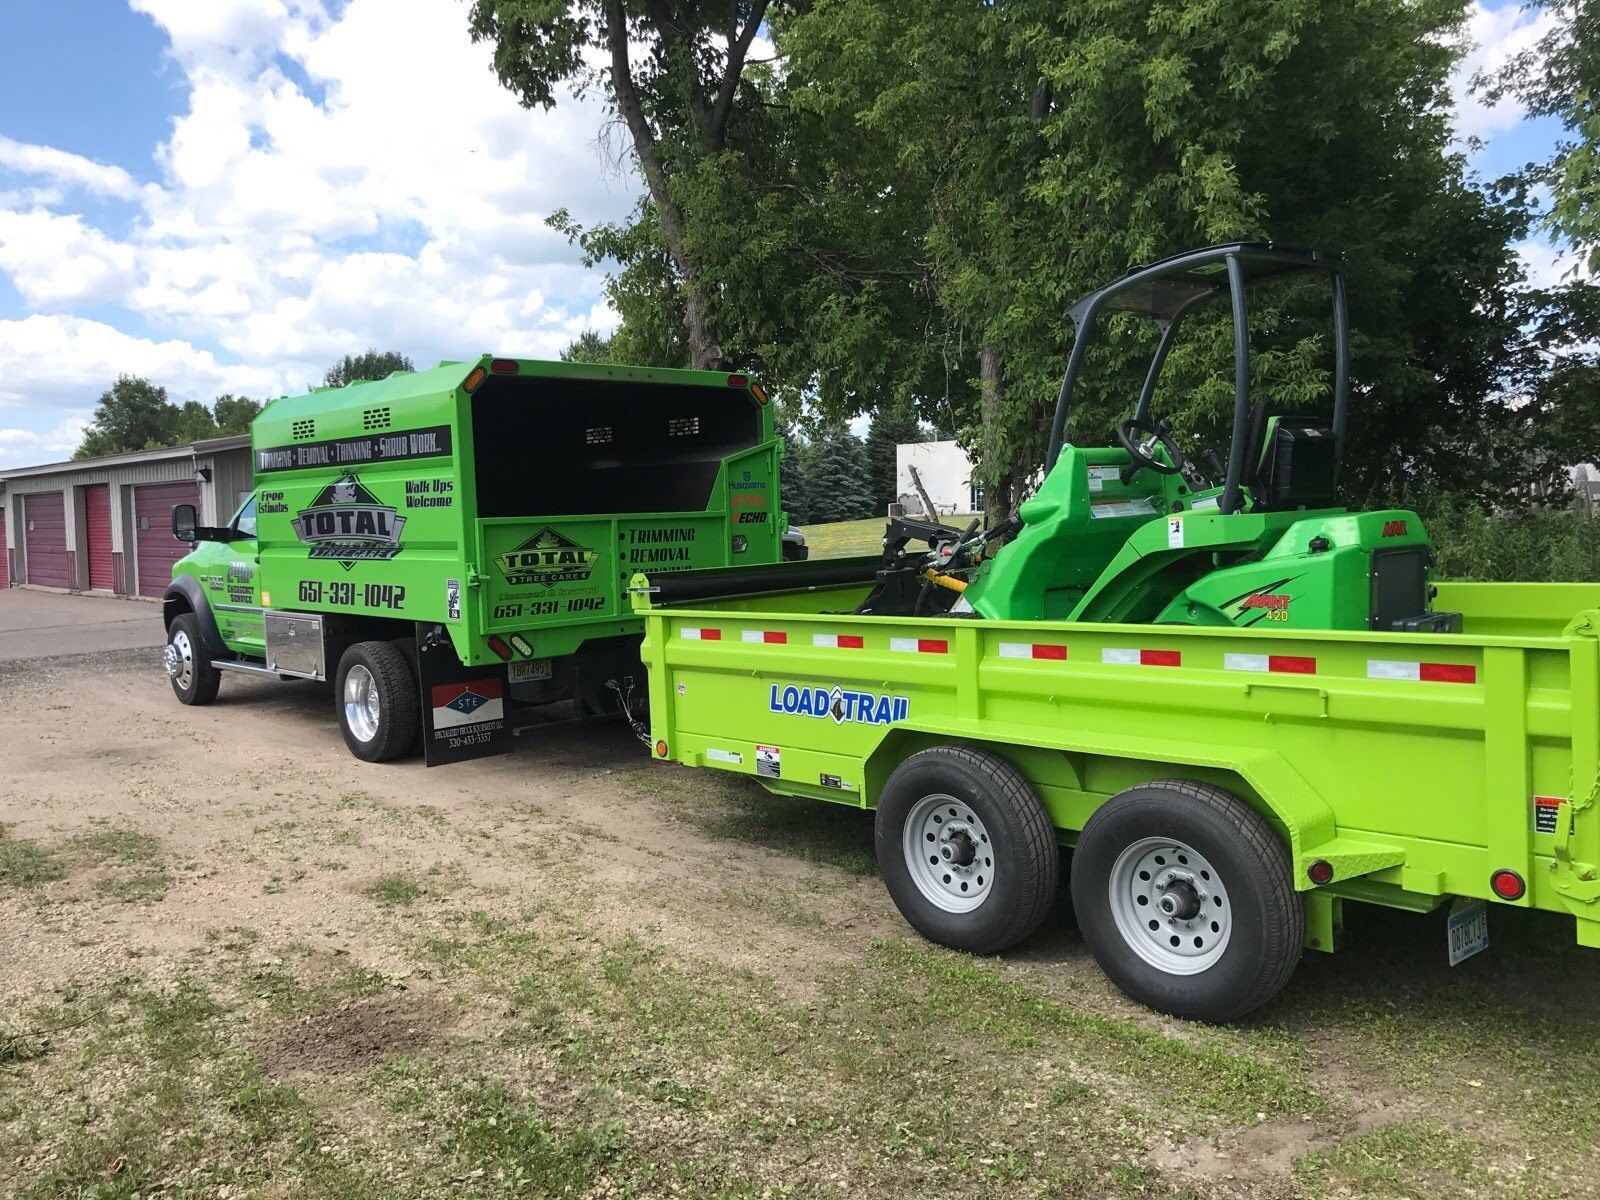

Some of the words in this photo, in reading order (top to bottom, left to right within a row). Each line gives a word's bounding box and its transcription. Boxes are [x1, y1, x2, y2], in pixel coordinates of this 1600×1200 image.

[298, 445, 330, 466] REMOVAL
[335, 440, 372, 462] THINNING
[379, 435, 407, 458] SHRUB
[405, 480, 430, 494] Walk
[432, 479, 454, 494] Ups
[728, 481, 766, 491] Husqvarna
[261, 491, 284, 502] Free
[406, 495, 453, 508] Welcome
[258, 502, 289, 514] Estimates
[302, 511, 391, 536] TOTAL
[738, 512, 768, 523] ECHO
[629, 528, 696, 544] TRIMMING
[352, 549, 385, 558] CARE
[506, 551, 588, 568] TOTAL
[630, 547, 691, 564] REMOVAL
[520, 575, 547, 583] TREE
[551, 573, 580, 581] CARE
[299, 580, 406, 610] 651-331-1042
[1243, 594, 1291, 609] AVANT
[493, 597, 606, 619] 651-331-1042
[1266, 610, 1289, 622] 420
[458, 697, 478, 709] STE
[769, 684, 831, 718] LOAD
